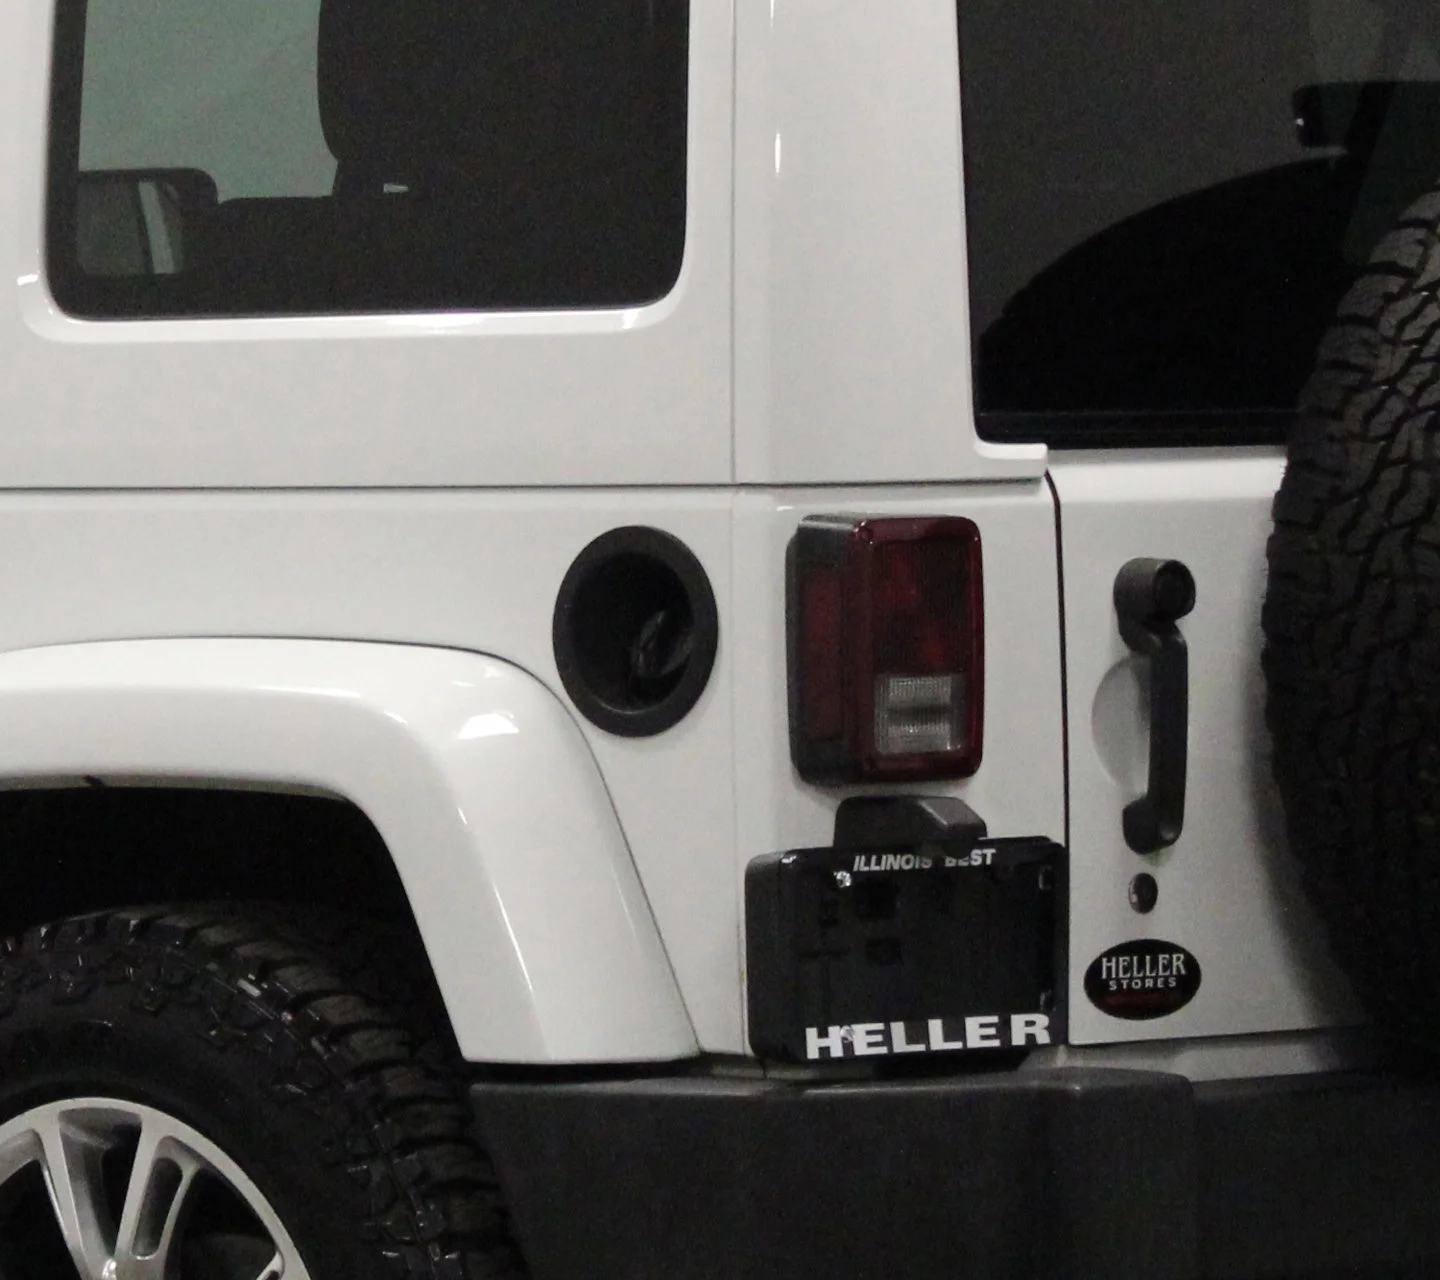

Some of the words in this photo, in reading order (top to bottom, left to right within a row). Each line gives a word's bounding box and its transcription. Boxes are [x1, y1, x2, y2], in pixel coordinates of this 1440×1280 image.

[1101, 953, 1187, 980] HELLER
[1109, 977, 1177, 991] STORES
[804, 1012, 1051, 1060] HELLER
